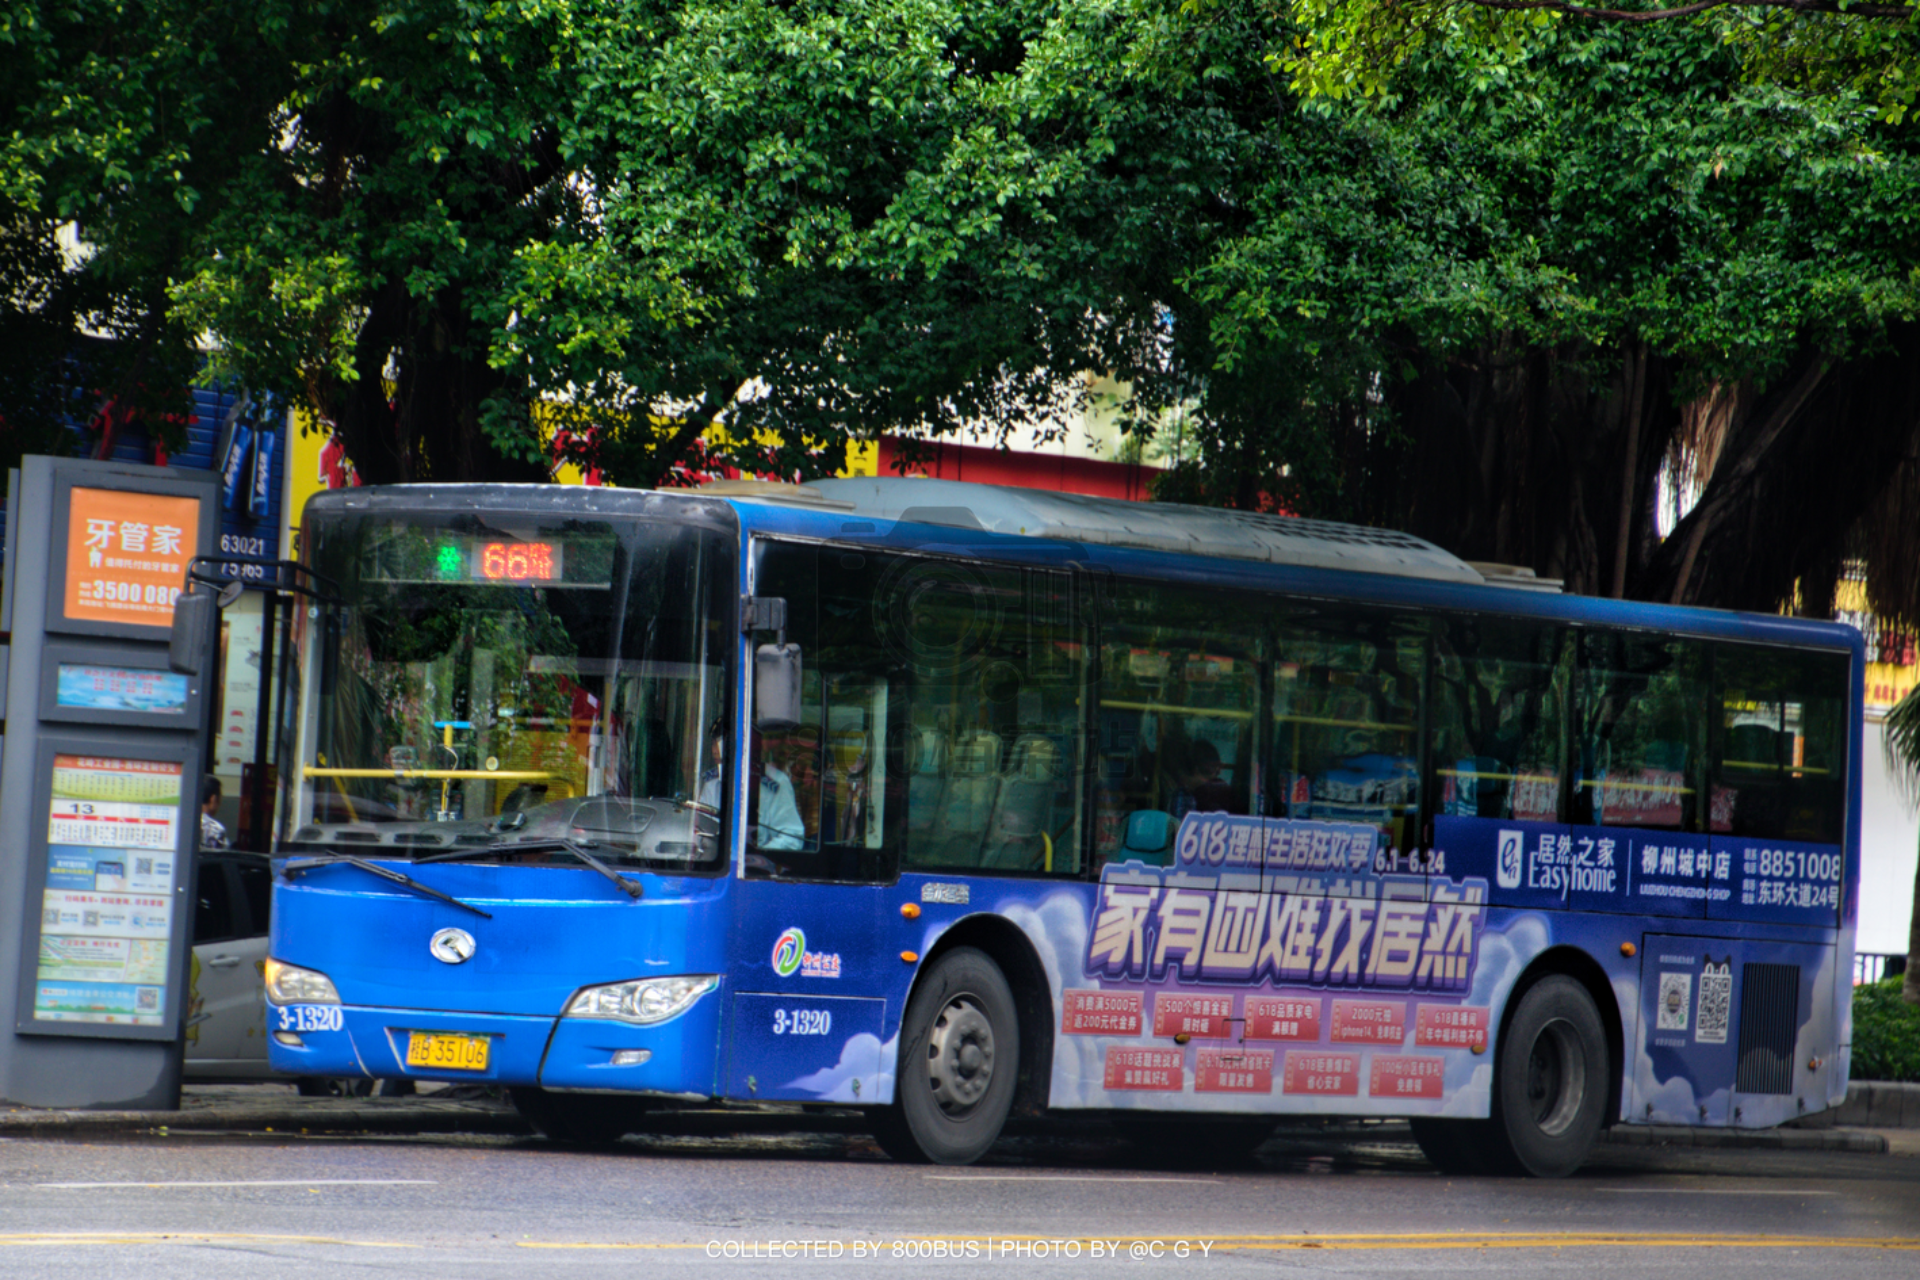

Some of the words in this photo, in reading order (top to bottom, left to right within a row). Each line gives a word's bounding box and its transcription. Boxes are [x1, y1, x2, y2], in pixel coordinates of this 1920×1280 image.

[84, 518, 183, 555] 牙管家
[220, 533, 265, 555] 63021
[93, 579, 142, 603] 3500
[145, 584, 181, 607] 080
[70, 803, 95, 815] 13
[1180, 819, 1372, 869] 618理想生活狂欢季
[1537, 834, 1616, 868] 居然之家
[1528, 852, 1616, 901] Easyhome
[1641, 845, 1732, 881] 柳州城中店
[1759, 849, 1841, 882] 8851008
[1757, 880, 1839, 911] 东环大道24号
[1089, 870, 1484, 980] 家有困难找居然
[1075, 996, 1138, 1013] 消费满5000元
[1165, 1000, 1229, 1017] 500个惊喜金蛋
[1259, 1003, 1313, 1019] 618品质家电
[278, 1005, 344, 1033] 3-1320
[772, 1009, 832, 1036] 3-1320
[1074, 1014, 1137, 1031] 返200元代金券
[1434, 1012, 1477, 1027] 618直播间
